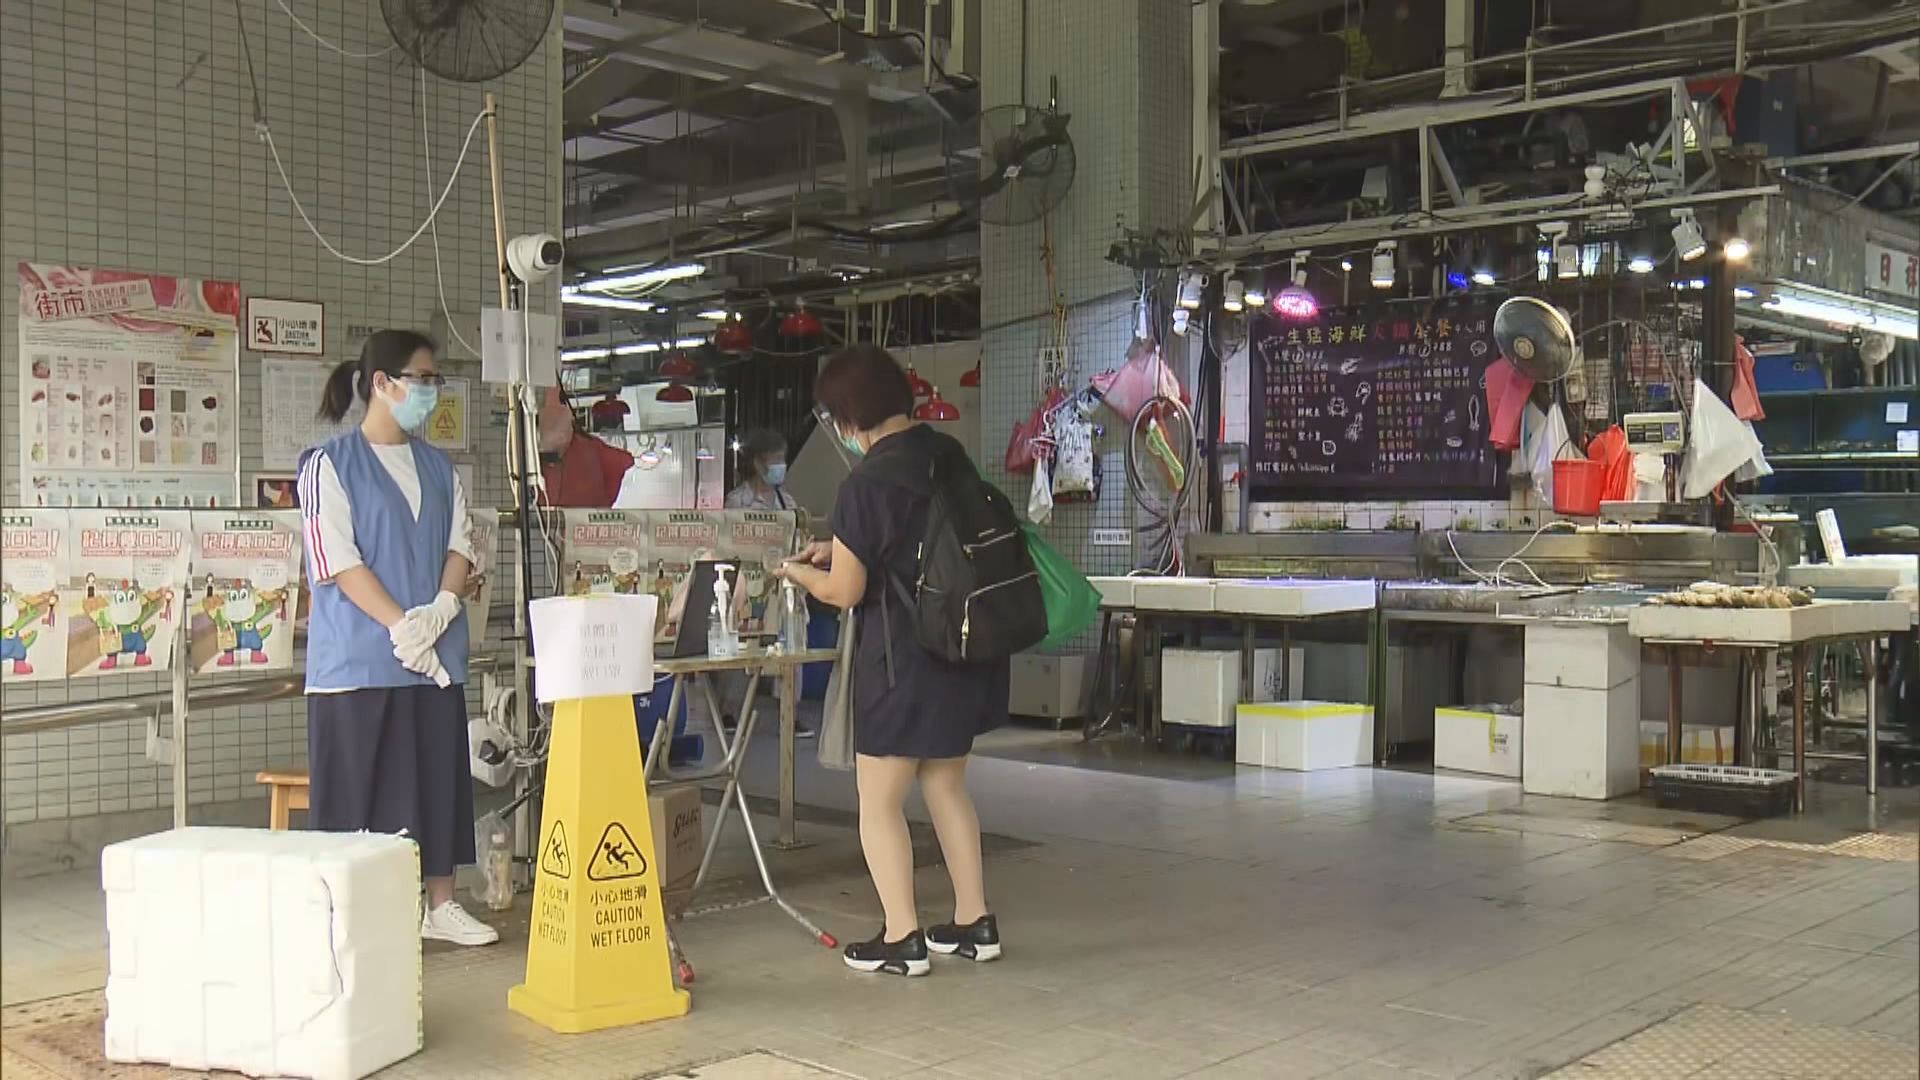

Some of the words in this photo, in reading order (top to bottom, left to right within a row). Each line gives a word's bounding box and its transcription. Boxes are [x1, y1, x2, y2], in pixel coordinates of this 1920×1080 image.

[35, 288, 85, 319] 街市
[590, 884, 647, 905] 小心地滑
[542, 902, 565, 924] CAUTION
[596, 906, 643, 926] CAUTION
[591, 930, 614, 948] WET
[616, 926, 651, 945] FLOOR
